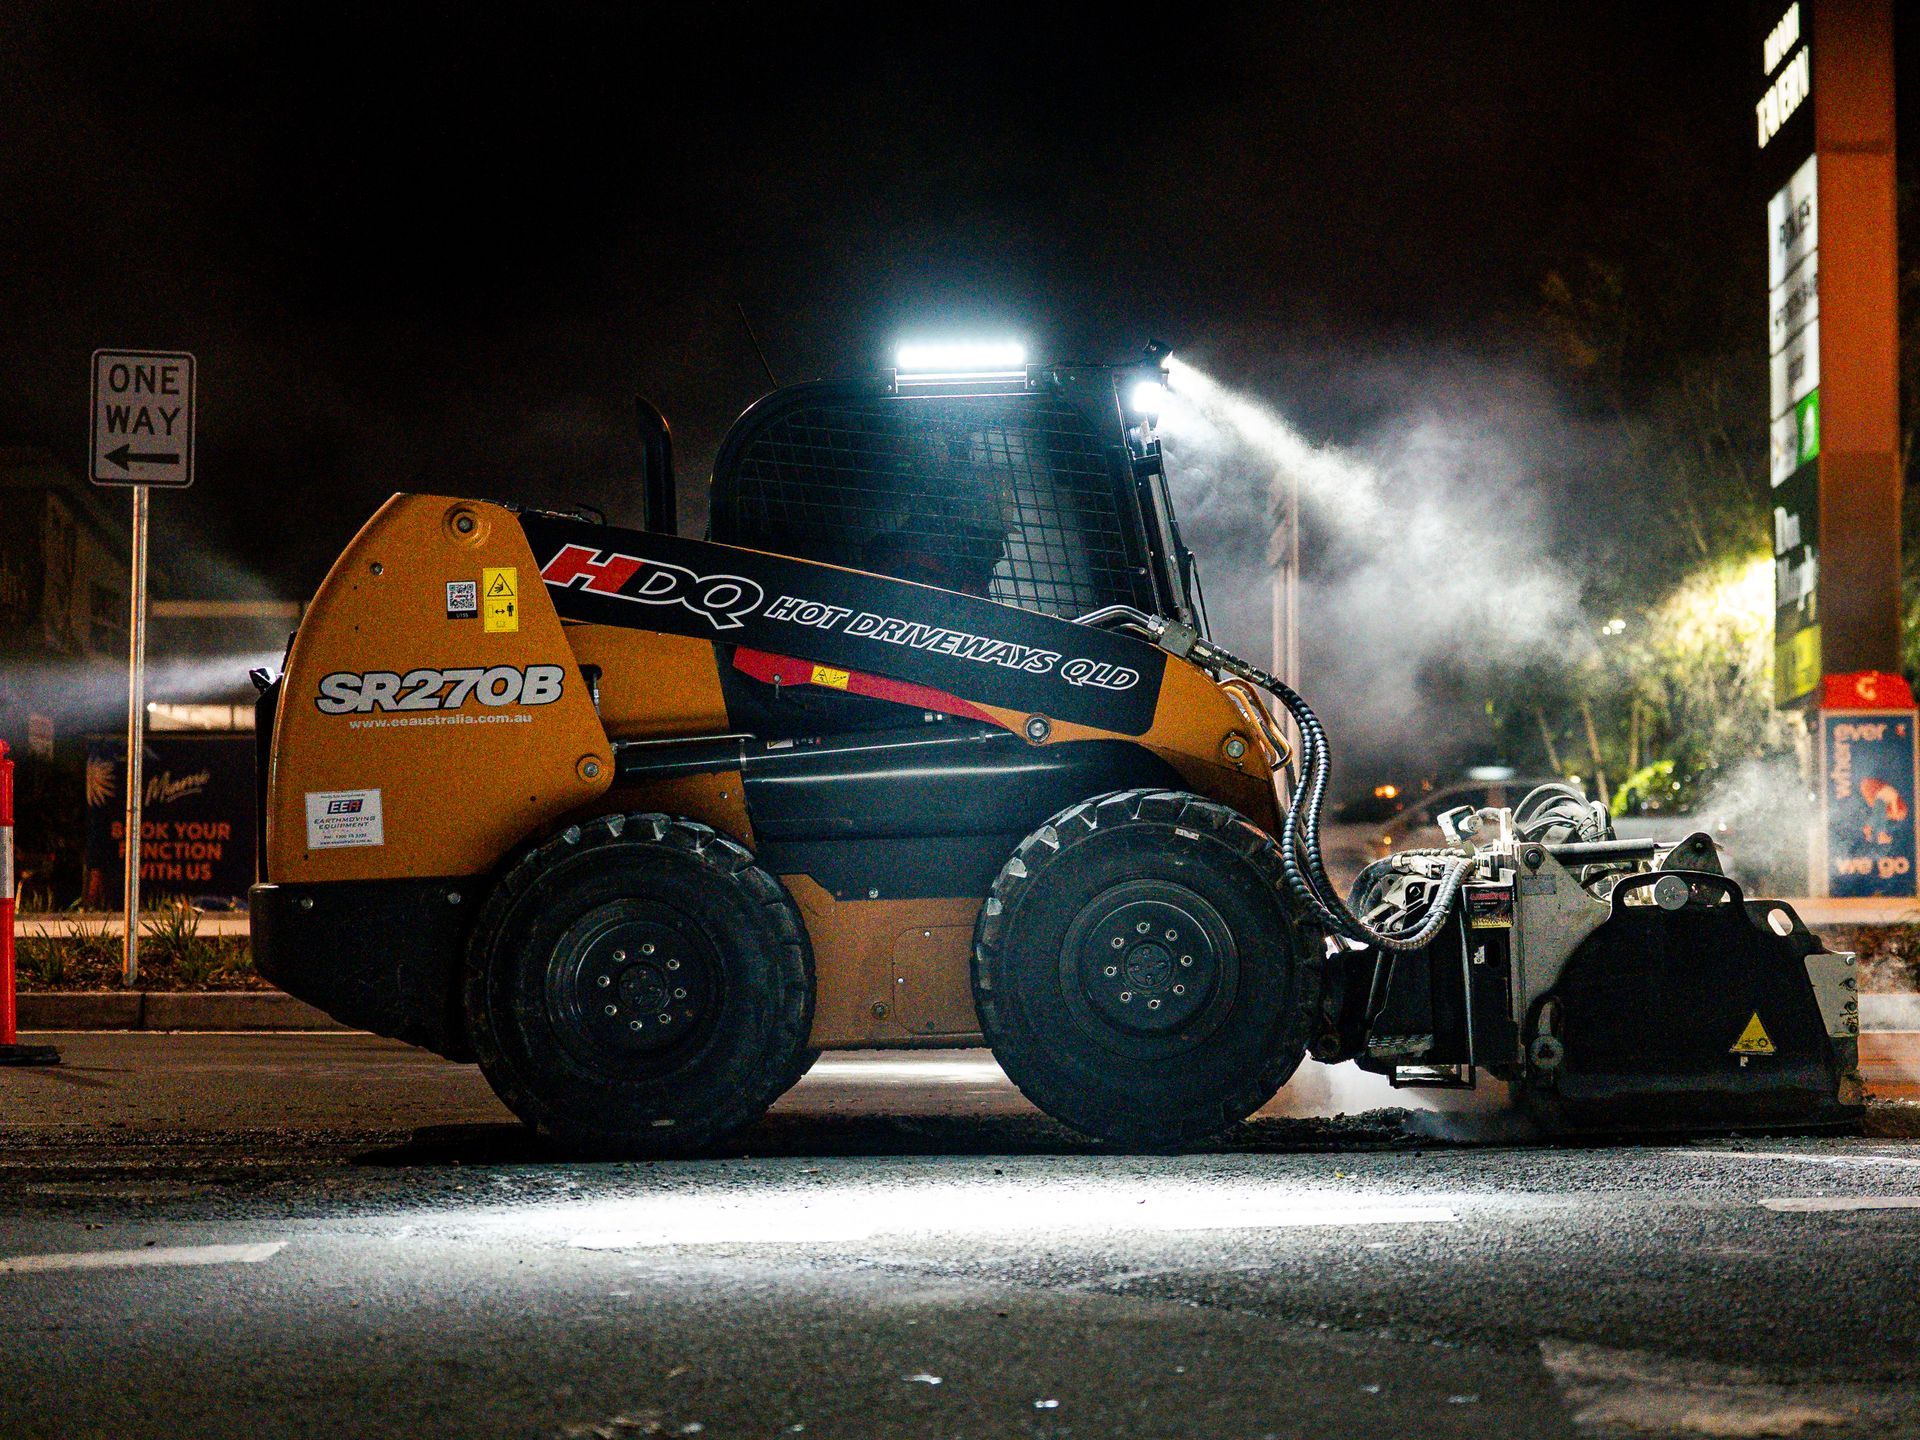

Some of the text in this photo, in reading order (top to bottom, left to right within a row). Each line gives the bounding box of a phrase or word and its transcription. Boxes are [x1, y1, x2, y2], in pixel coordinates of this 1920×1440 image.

[109, 364, 180, 394] ONE
[106, 405, 181, 436] WAY
[540, 543, 1140, 690] HDQ HOT DRIVEWAYS QLD
[314, 664, 565, 715] SR270B
[350, 714, 532, 729] www.eeaustralia.com.au
[331, 801, 361, 812] EEA
[314, 815, 376, 824] EARTHMOVING
[319, 821, 369, 829] EQUIPMENT
[111, 822, 231, 840] BOK YOUR
[118, 842, 222, 859] FNCTION
[186, 863, 212, 880] US
[1877, 855, 1910, 879] go
